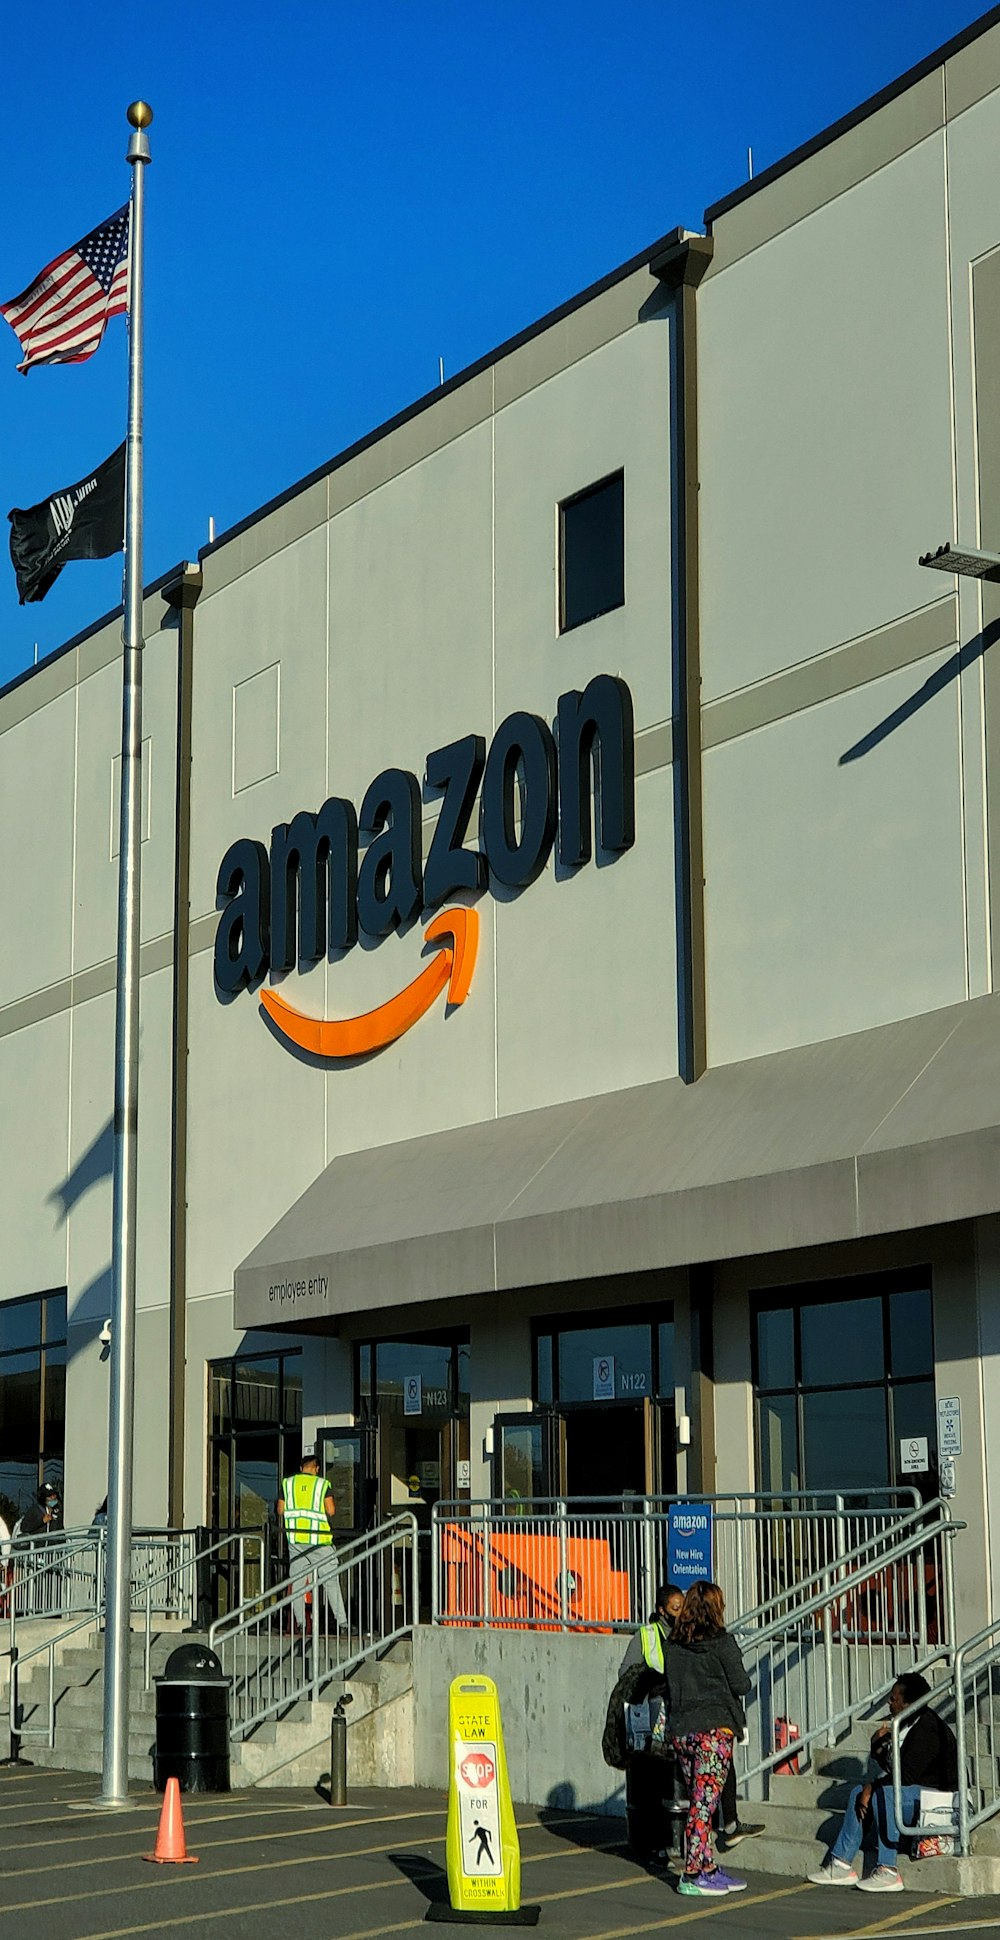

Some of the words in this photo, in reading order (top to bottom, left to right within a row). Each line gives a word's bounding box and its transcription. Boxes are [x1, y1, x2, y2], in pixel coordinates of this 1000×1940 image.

[214, 673, 635, 995] amazon
[269, 1279, 306, 1305] employee
[308, 1274, 328, 1298] entry
[621, 1373, 646, 1390] N122
[427, 1390, 447, 1407] N123
[673, 1515, 707, 1529] amazon
[676, 1549, 689, 1560] New
[690, 1548, 704, 1560] Hire
[673, 1563, 708, 1576] Orientation
[458, 1715, 491, 1725] STATE
[464, 1728, 486, 1738] LAW
[462, 1763, 493, 1779] SOP
[470, 1799, 488, 1809] FOR
[471, 1878, 497, 1888] WITHIN
[464, 1888, 505, 1898] CROSSWALK
